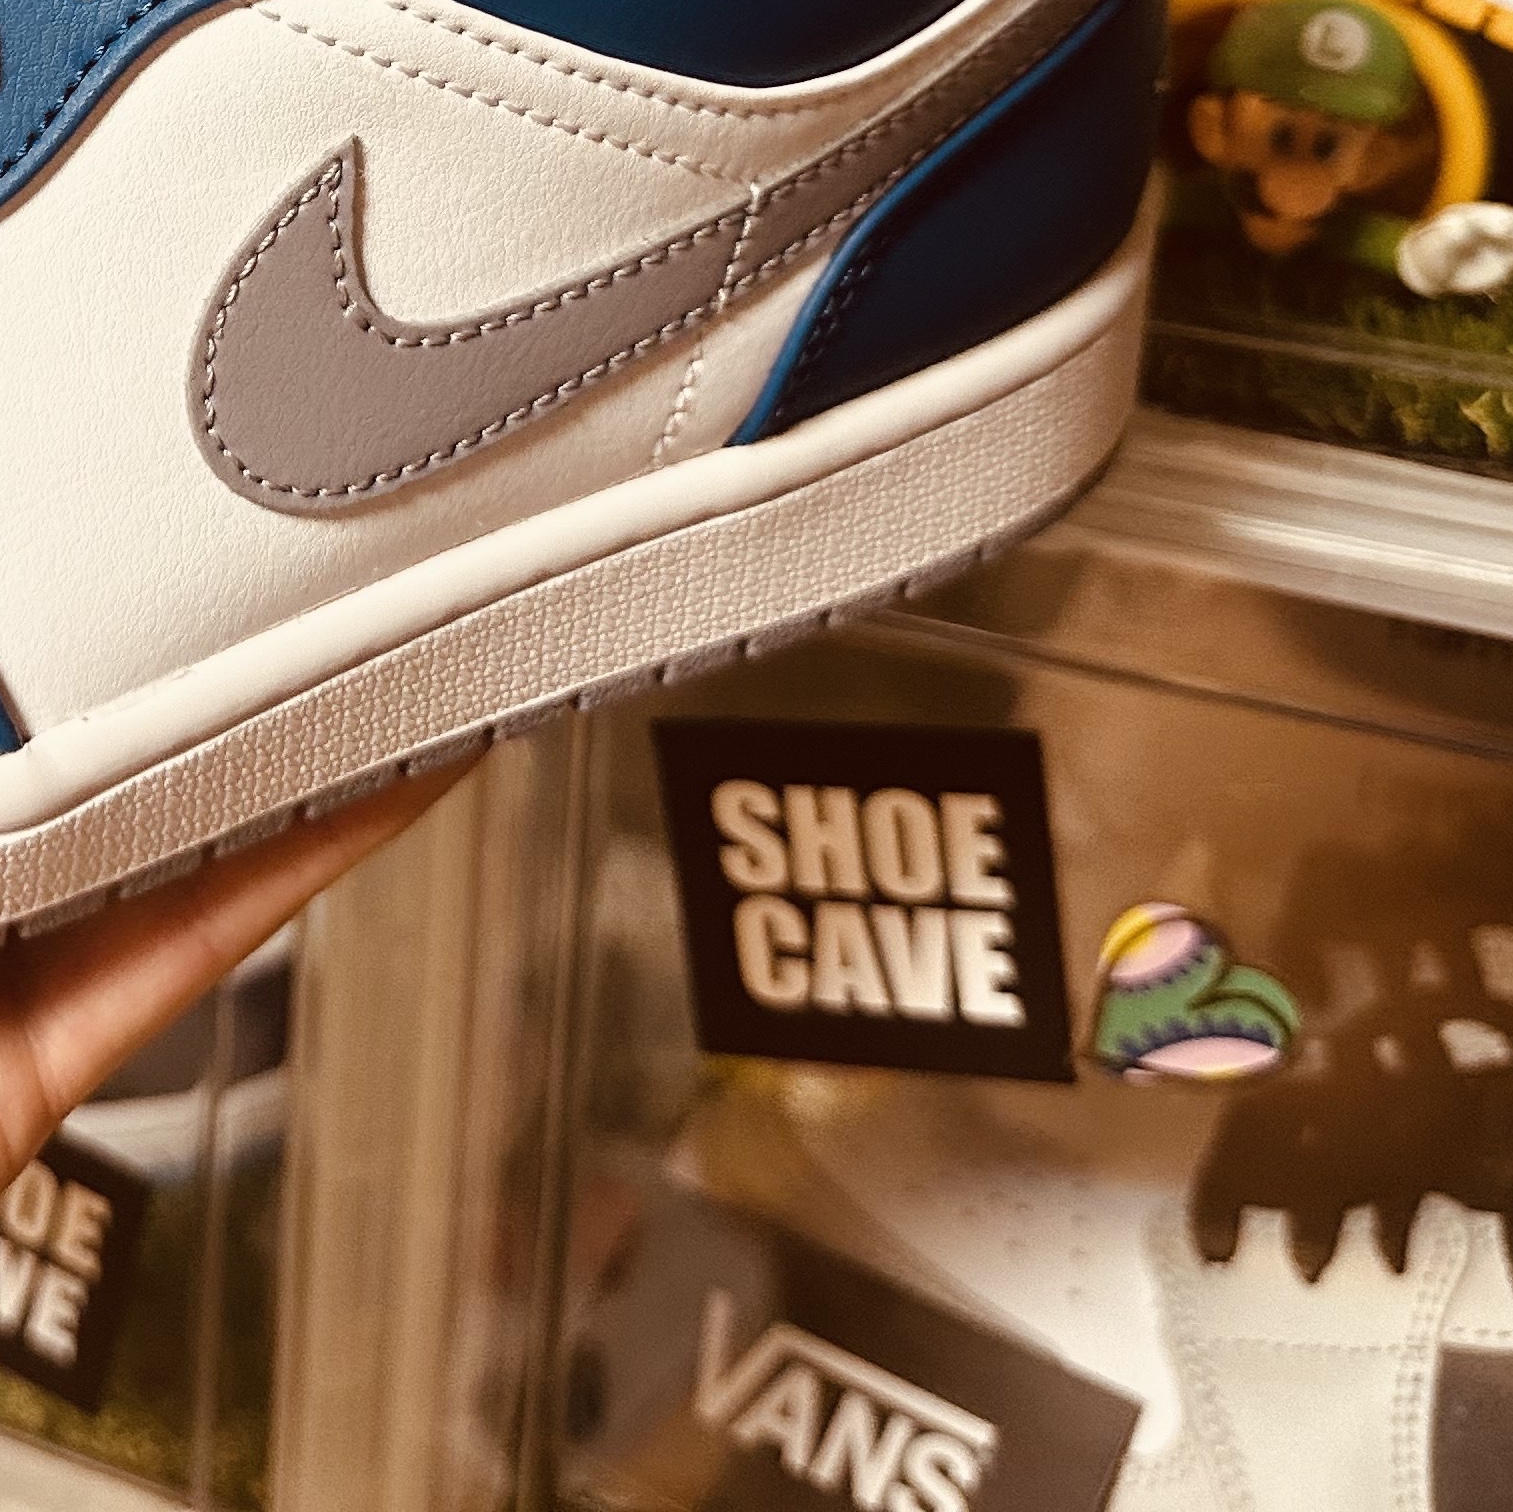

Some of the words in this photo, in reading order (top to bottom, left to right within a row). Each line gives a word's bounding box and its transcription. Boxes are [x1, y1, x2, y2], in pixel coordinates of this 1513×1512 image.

[710, 778, 1016, 908] SHOE
[732, 893, 1027, 1030] CAVE
[692, 1287, 998, 1511] VANS
